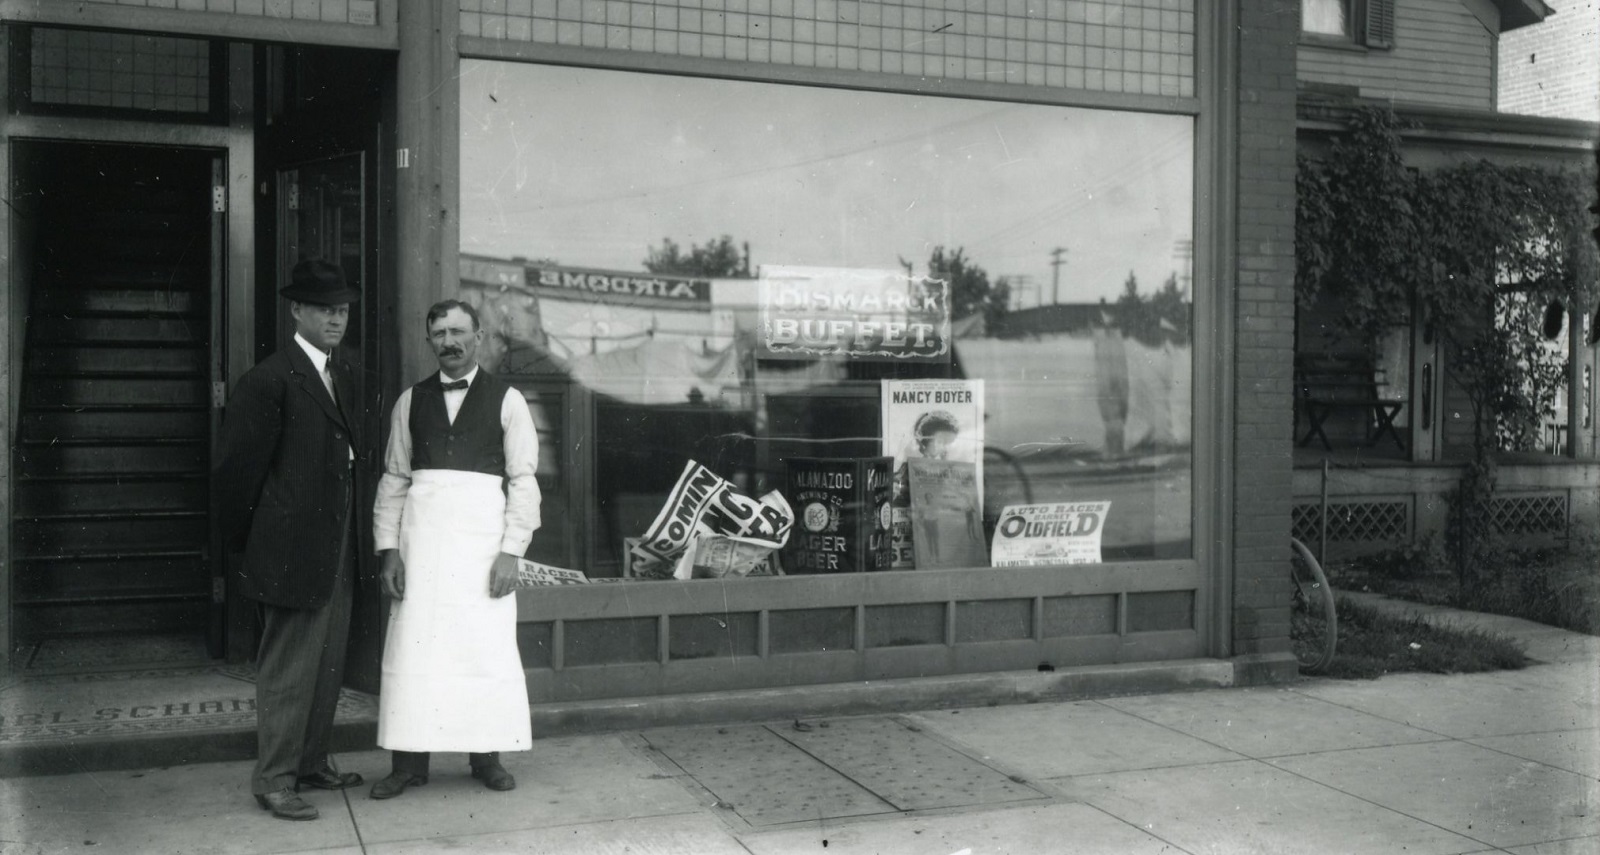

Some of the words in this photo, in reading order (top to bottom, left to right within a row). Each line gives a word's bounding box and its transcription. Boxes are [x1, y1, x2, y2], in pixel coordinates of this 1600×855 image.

[771, 318, 935, 348] BUFFET.
[893, 391, 931, 404] NANCY
[935, 390, 973, 403] BOYER
[796, 472, 854, 489] ALAMAZOO
[1006, 506, 1049, 516] AUTO
[1054, 504, 1104, 513] RACES
[1000, 512, 1100, 538] OLDFIELD
[799, 536, 847, 552] AGER
[524, 563, 580, 578] RACES
